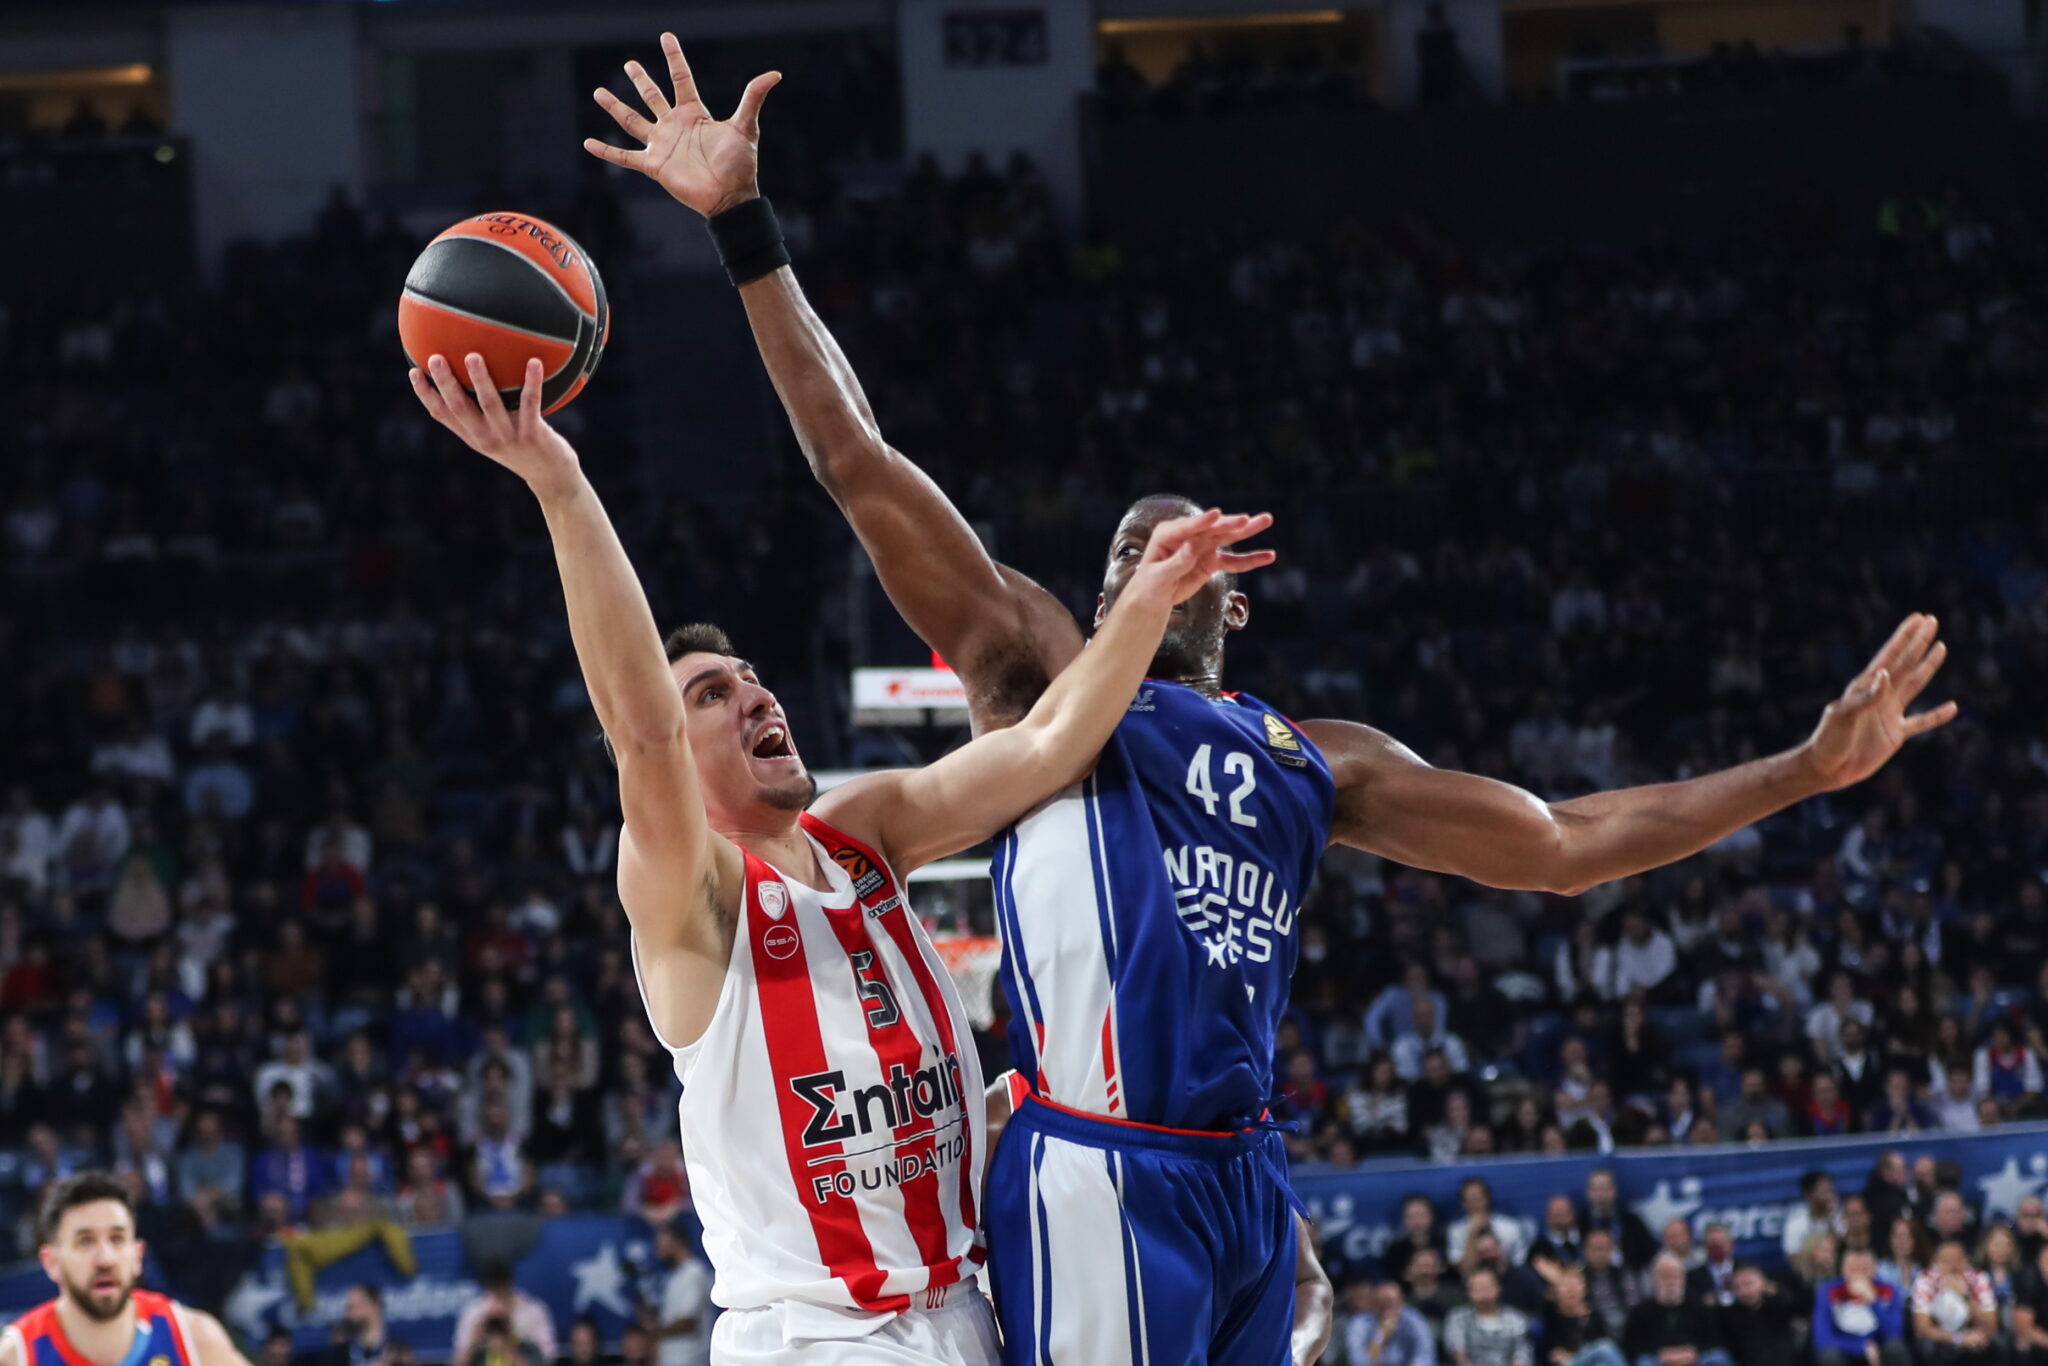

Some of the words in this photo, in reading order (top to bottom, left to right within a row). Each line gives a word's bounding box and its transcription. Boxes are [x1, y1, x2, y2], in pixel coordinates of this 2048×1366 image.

[476, 214, 573, 268] SPALDI
[1185, 743, 1257, 828] 42
[854, 869, 878, 888] URKISH
[766, 935, 797, 946] GSA
[850, 950, 900, 1028] 5
[812, 1133, 968, 1204] FOUNDATIO
